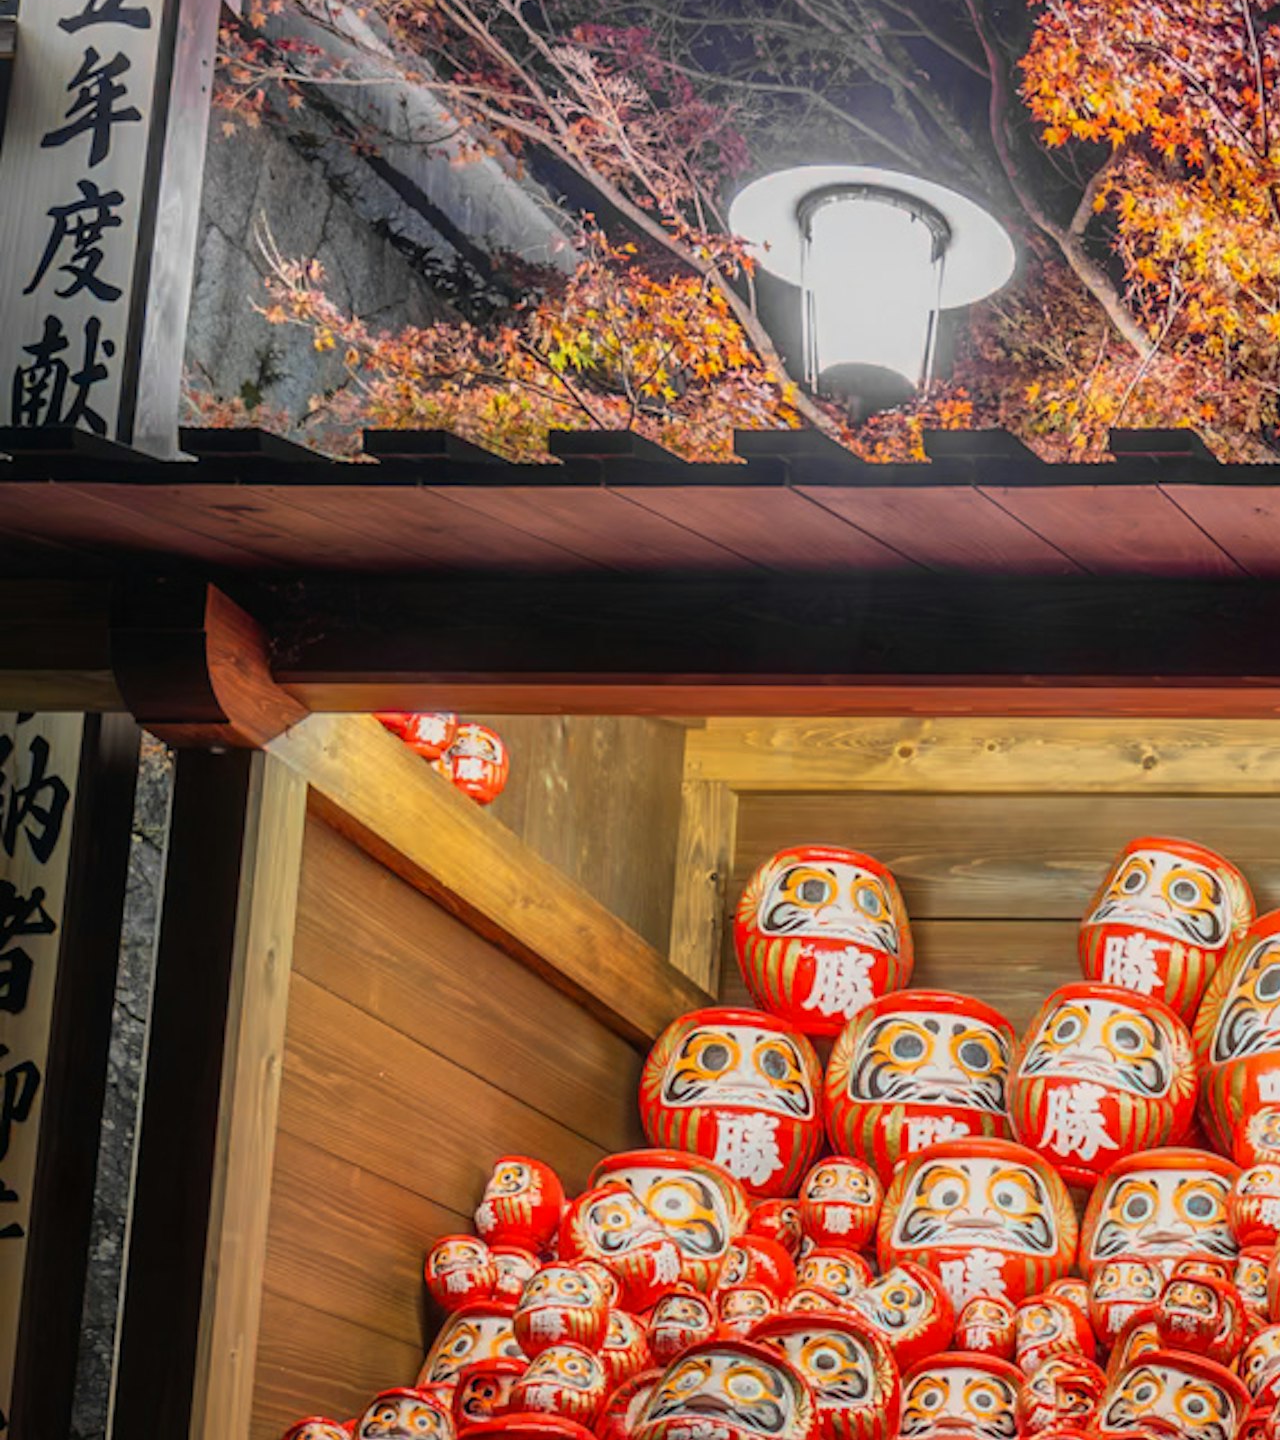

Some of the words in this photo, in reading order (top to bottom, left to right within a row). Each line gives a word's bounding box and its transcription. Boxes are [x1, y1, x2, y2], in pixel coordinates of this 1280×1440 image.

[803, 949, 876, 1018] 勝
[1103, 935, 1160, 993] 勝
[715, 1113, 781, 1187] 勝
[1040, 1083, 1118, 1160] 勝
[940, 1249, 1007, 1310] 勝
